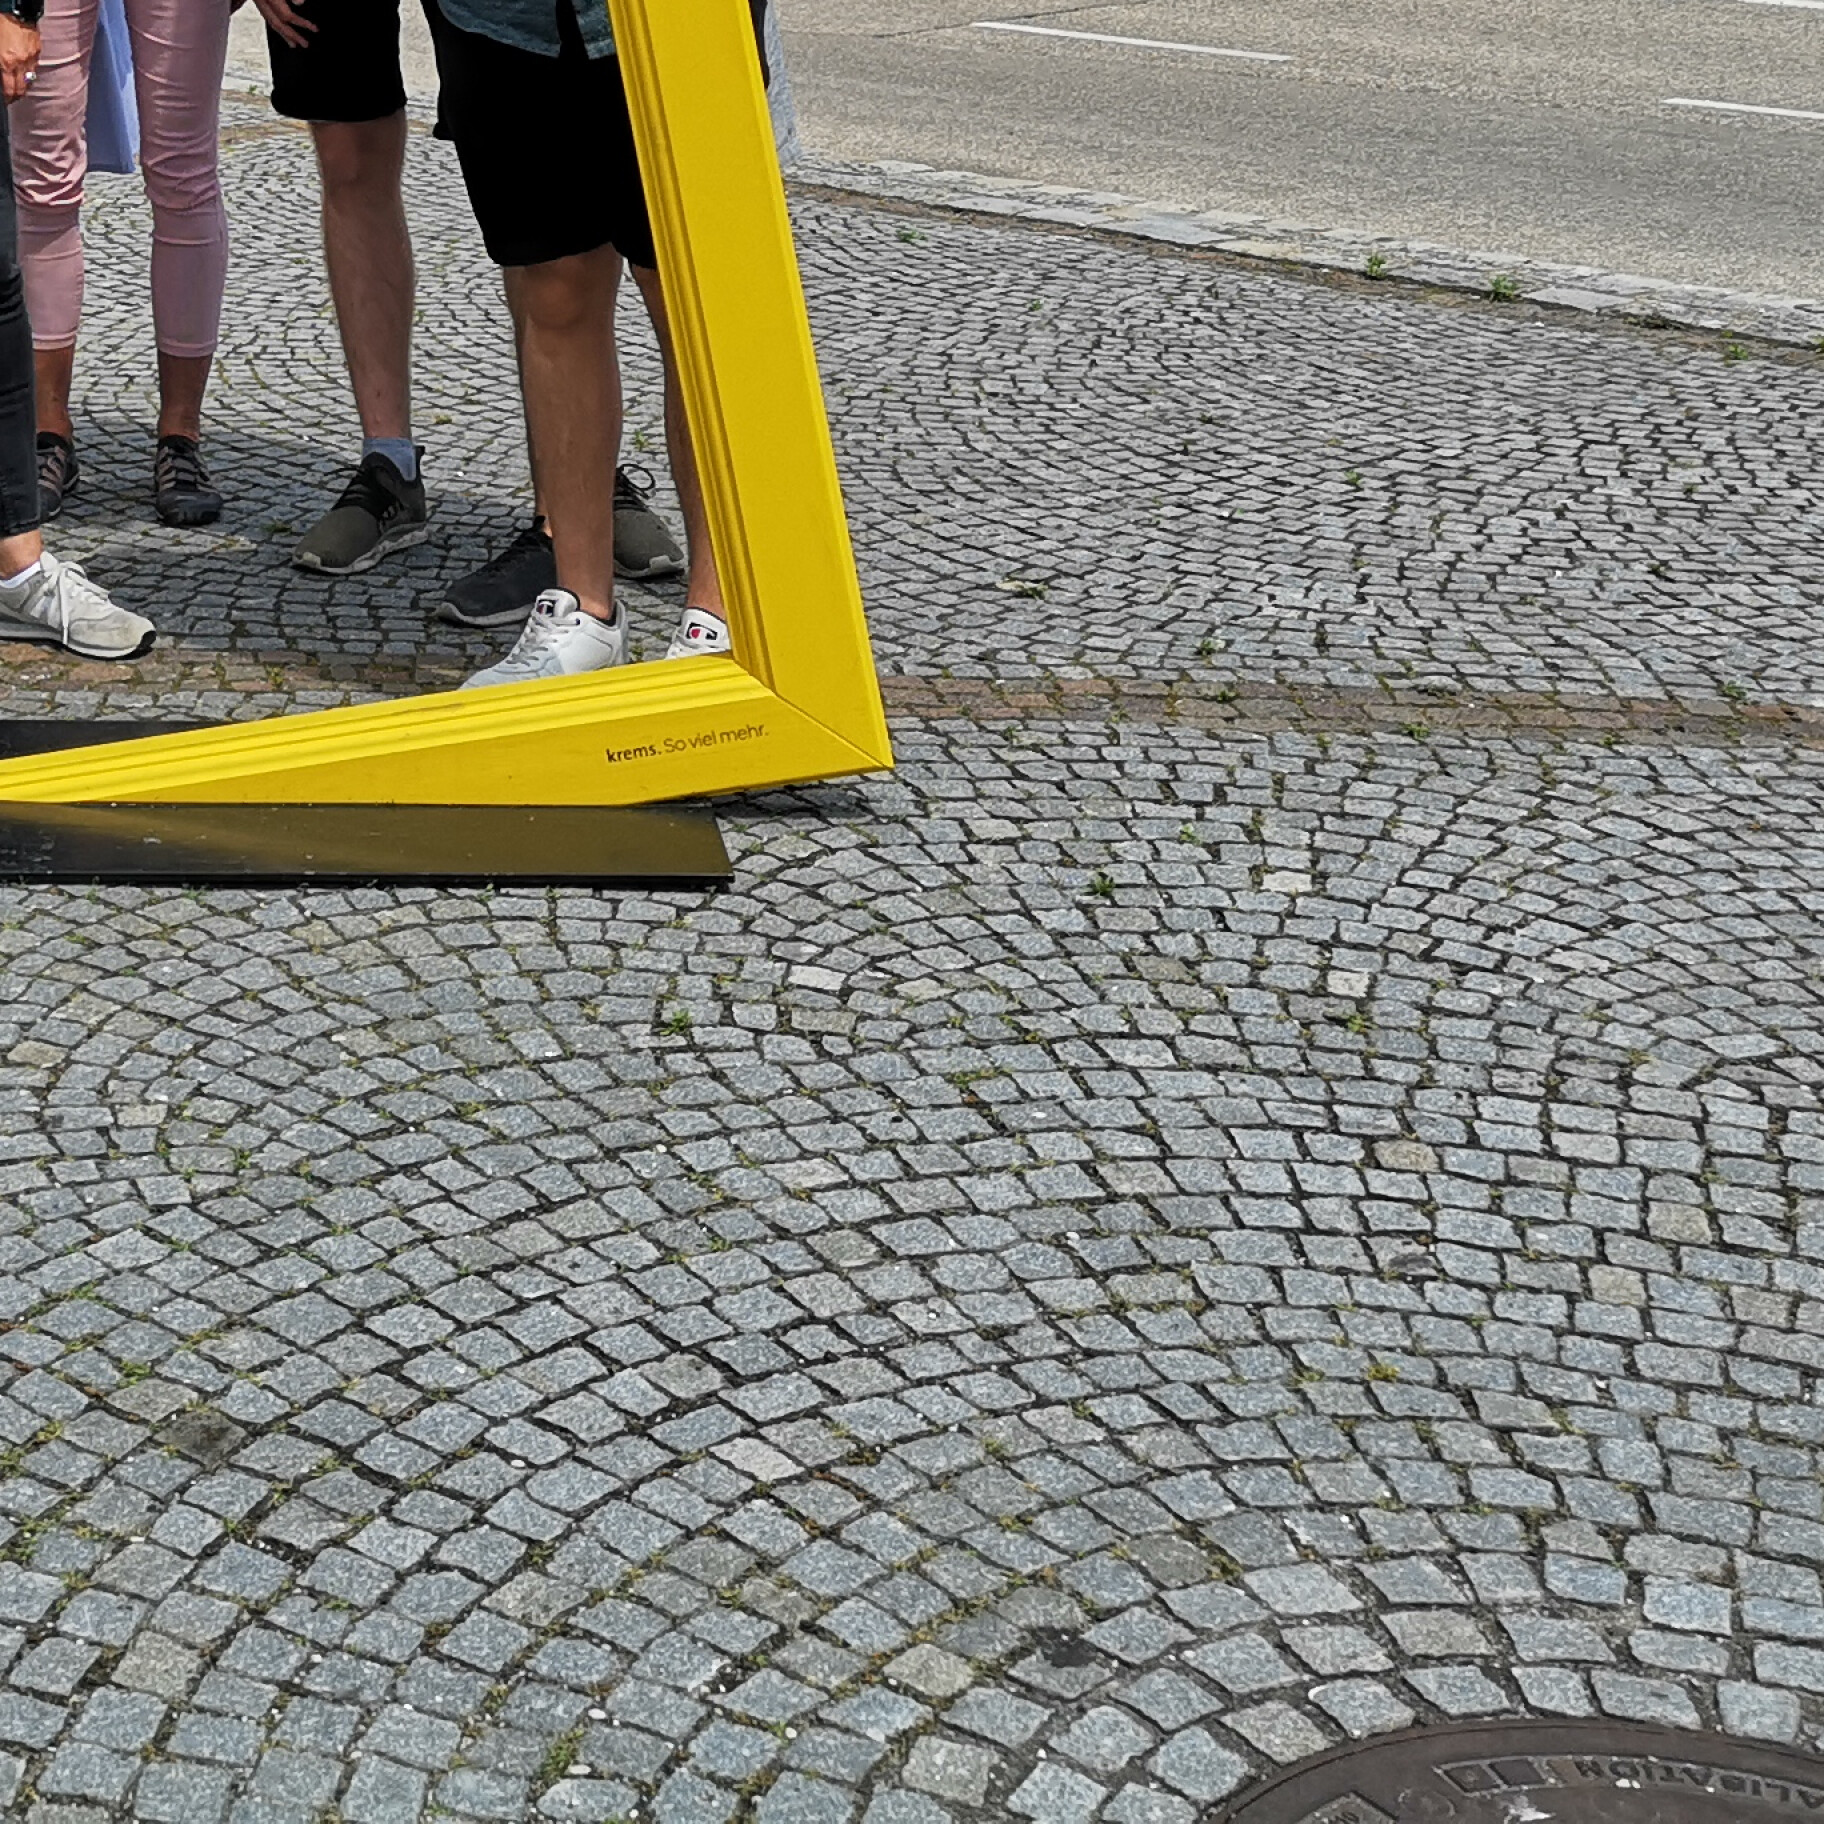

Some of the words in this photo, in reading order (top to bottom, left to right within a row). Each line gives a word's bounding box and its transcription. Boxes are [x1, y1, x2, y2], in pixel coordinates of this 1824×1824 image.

[606, 744, 662, 764] krems.
[663, 737, 687, 754] So
[690, 729, 717, 749] viel
[720, 723, 769, 744] mehr.
